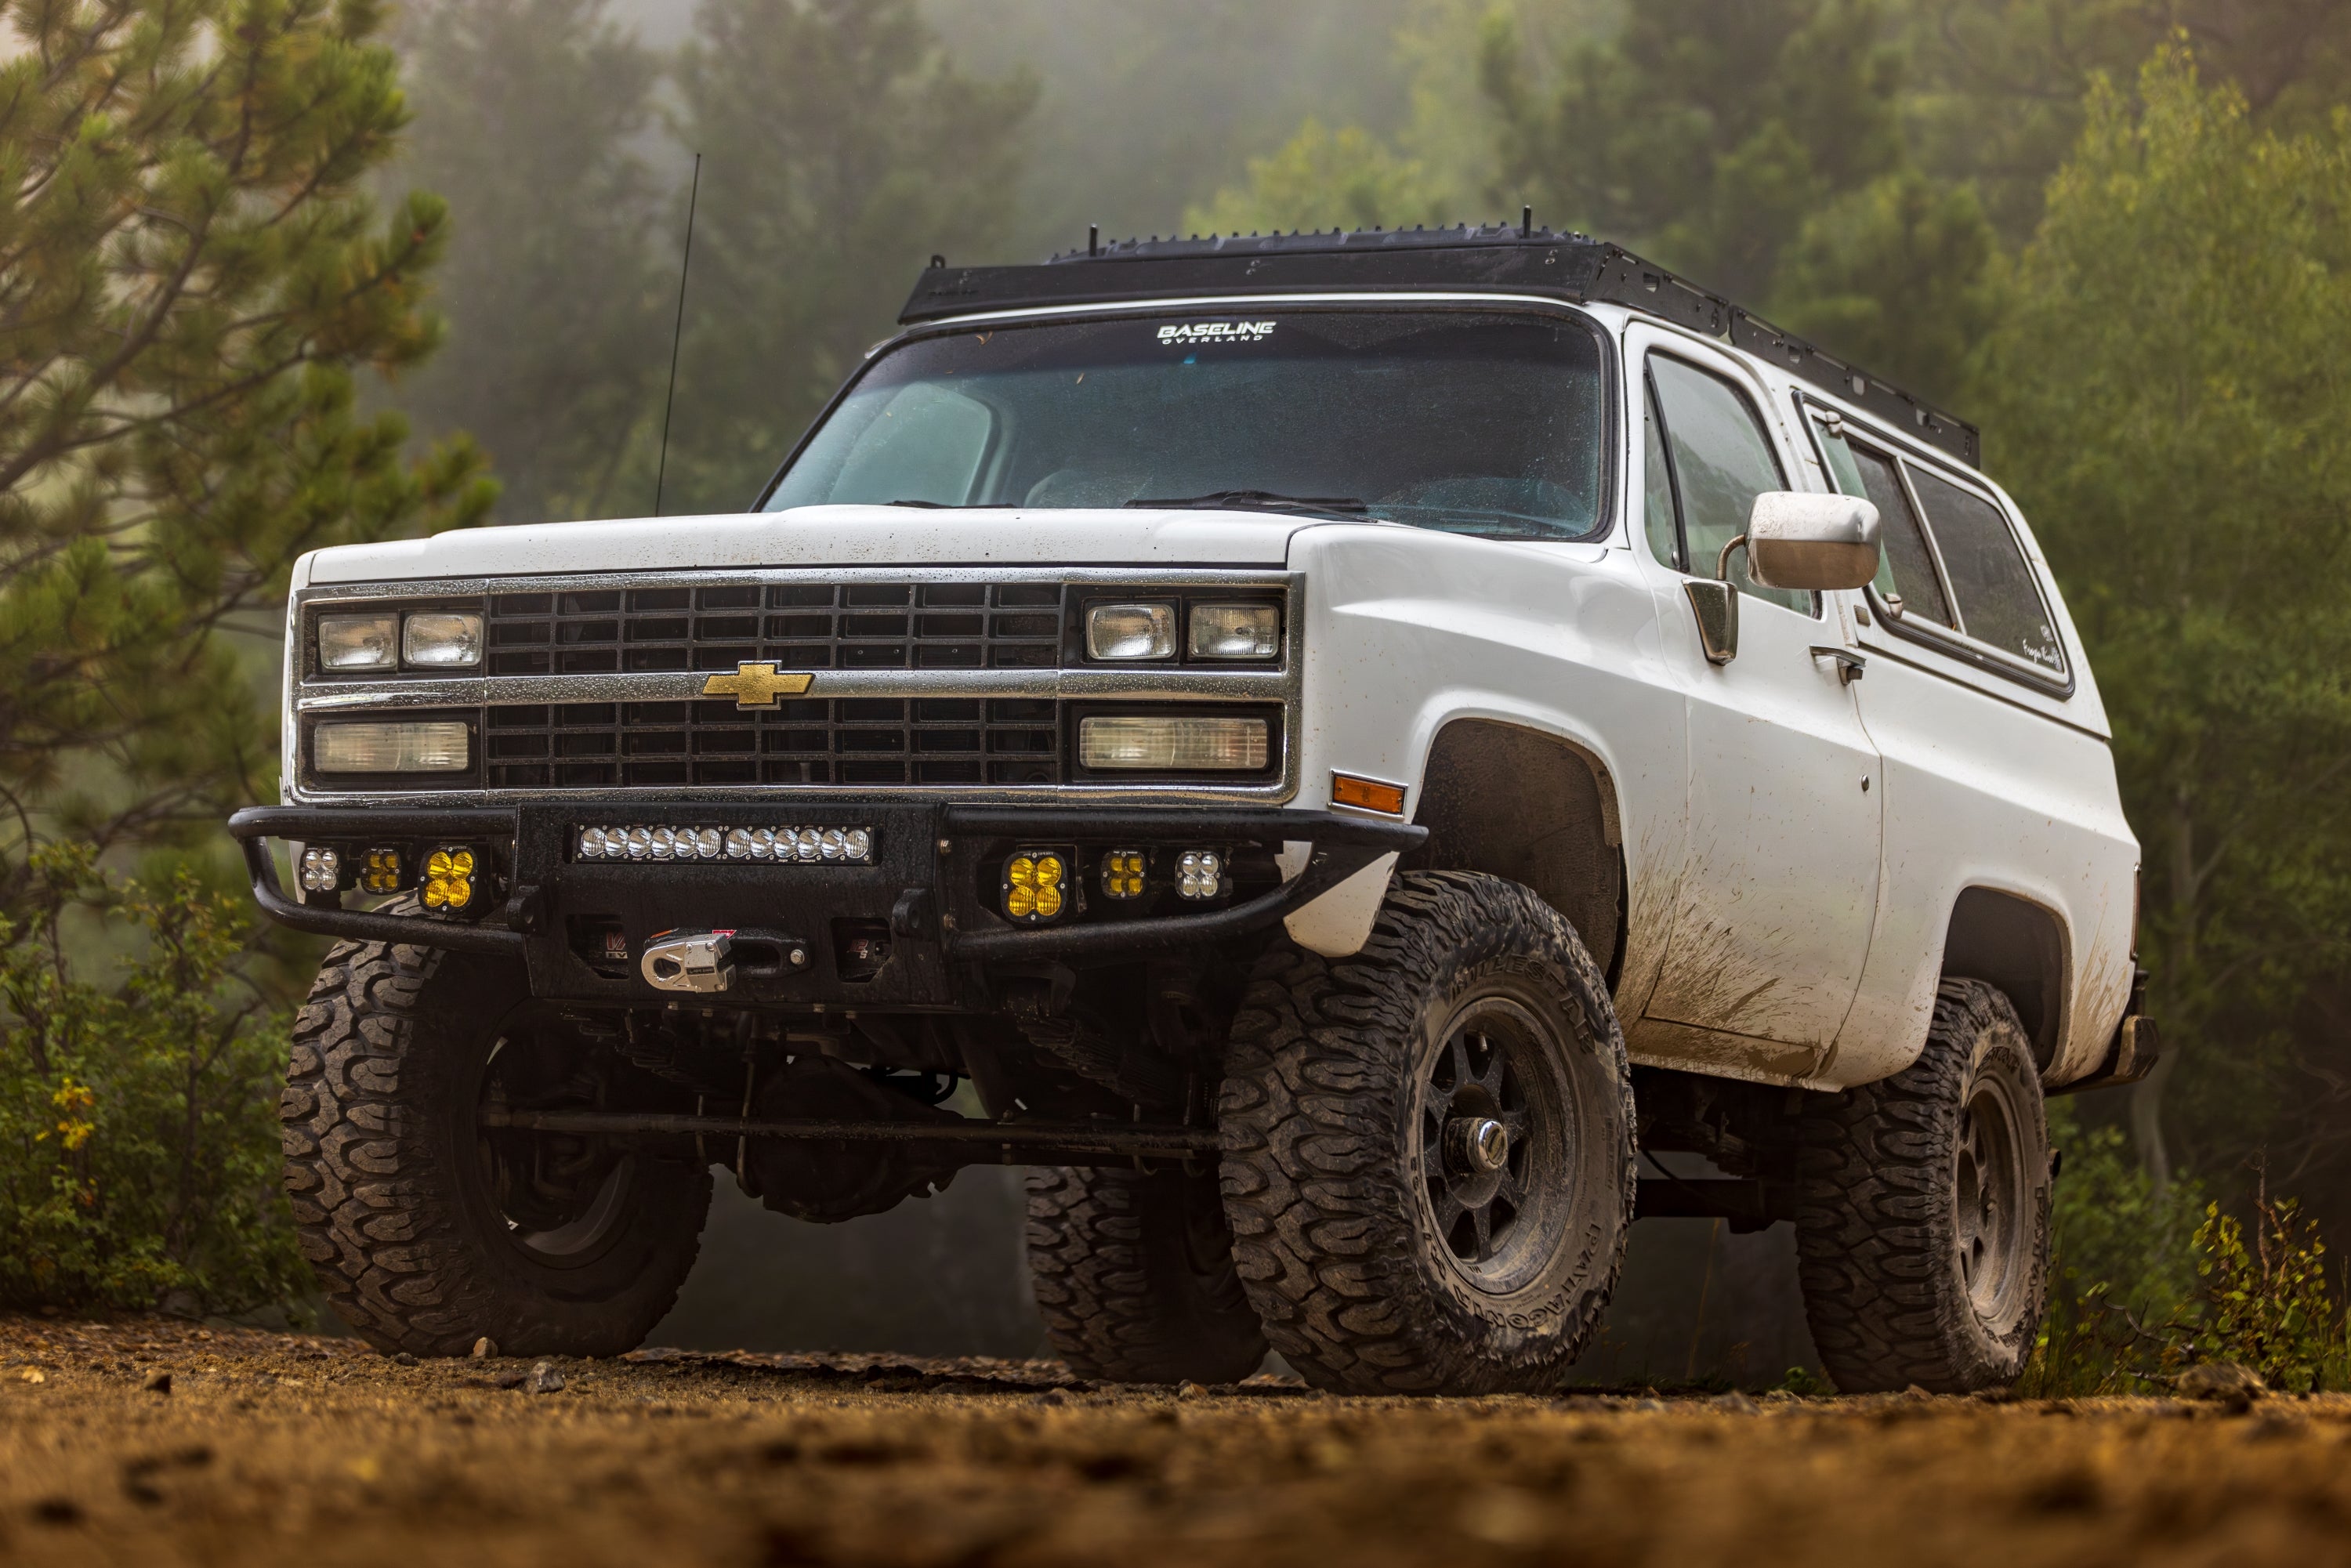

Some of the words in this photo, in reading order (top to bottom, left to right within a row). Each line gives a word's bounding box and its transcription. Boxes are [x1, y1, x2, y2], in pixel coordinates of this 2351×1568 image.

[1157, 321, 1277, 339] BASELINE
[1161, 335, 1263, 345] OVERLAND
[1454, 1223, 1602, 1330] PATAGONIA
